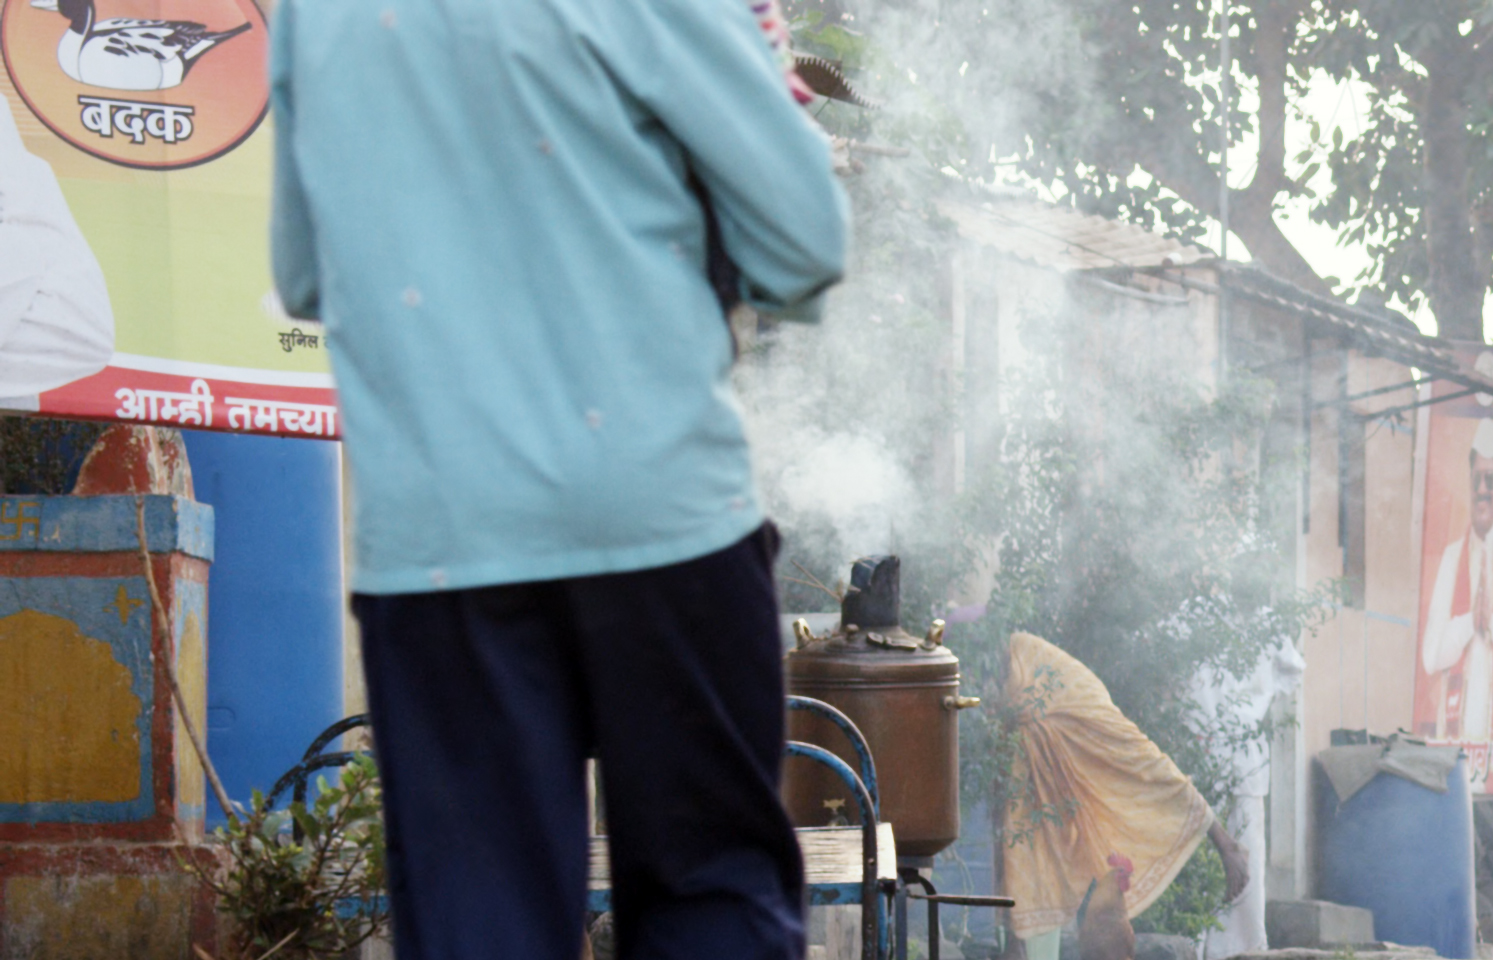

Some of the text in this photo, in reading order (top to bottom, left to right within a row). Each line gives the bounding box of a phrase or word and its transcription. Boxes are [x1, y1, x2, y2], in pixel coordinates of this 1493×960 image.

[77, 94, 194, 145] बदक
[278, 327, 318, 352] सुनिल
[114, 378, 215, 427] आम्ही
